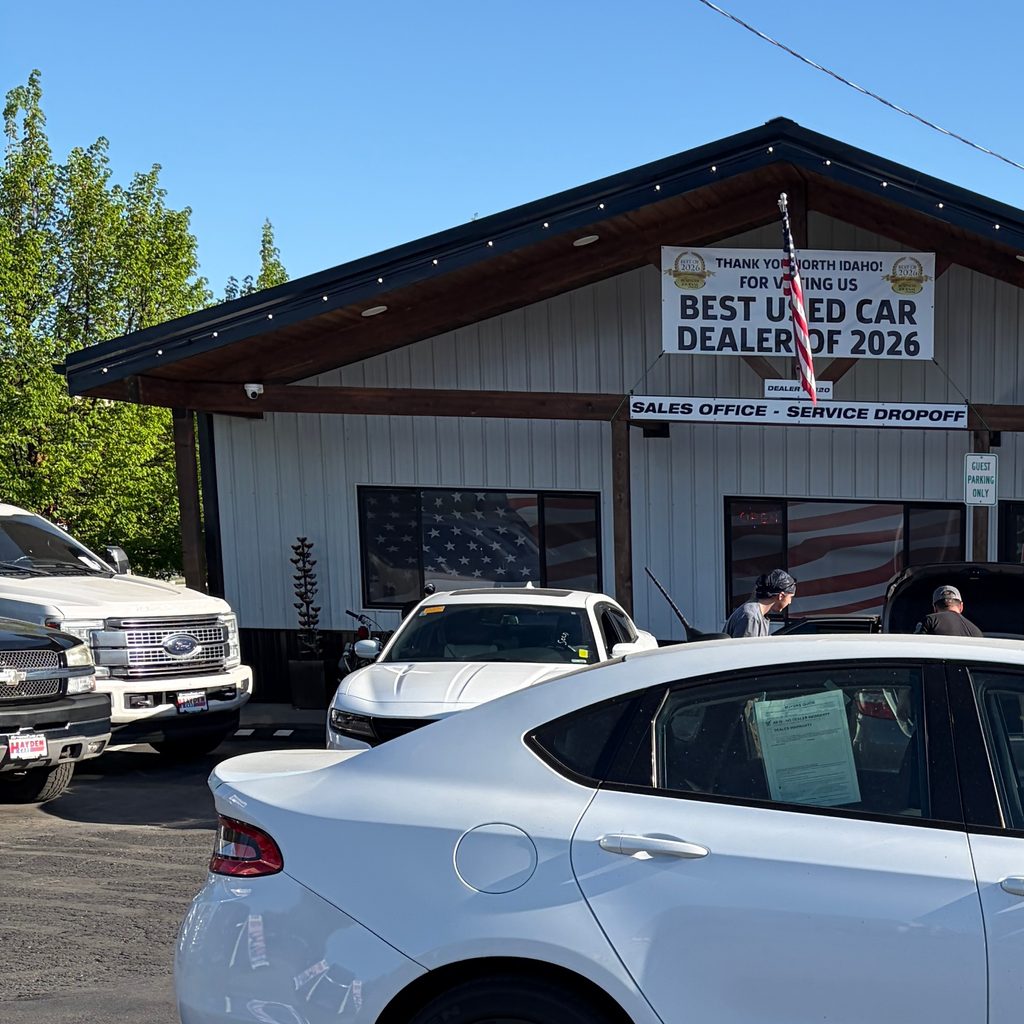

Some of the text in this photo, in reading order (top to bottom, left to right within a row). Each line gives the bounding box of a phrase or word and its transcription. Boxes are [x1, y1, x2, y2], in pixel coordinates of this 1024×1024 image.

[715, 258, 784, 270] THANK YO
[840, 260, 883, 272] IDAHO!
[740, 276, 768, 289] FOR
[838, 279, 858, 291] US
[680, 294, 917, 325] BEST UED CAR
[678, 325, 920, 357] DEALER OF 2026
[631, 401, 693, 415] SALES
[698, 403, 768, 417] OFFICE
[786, 405, 870, 420] SERVICE
[873, 408, 966, 422] DROPOFF
[971, 462, 991, 471] GUEST
[967, 475, 994, 485] PARKING
[972, 488, 989, 498] ONLY
[10, 740, 44, 754] HAYDEN
